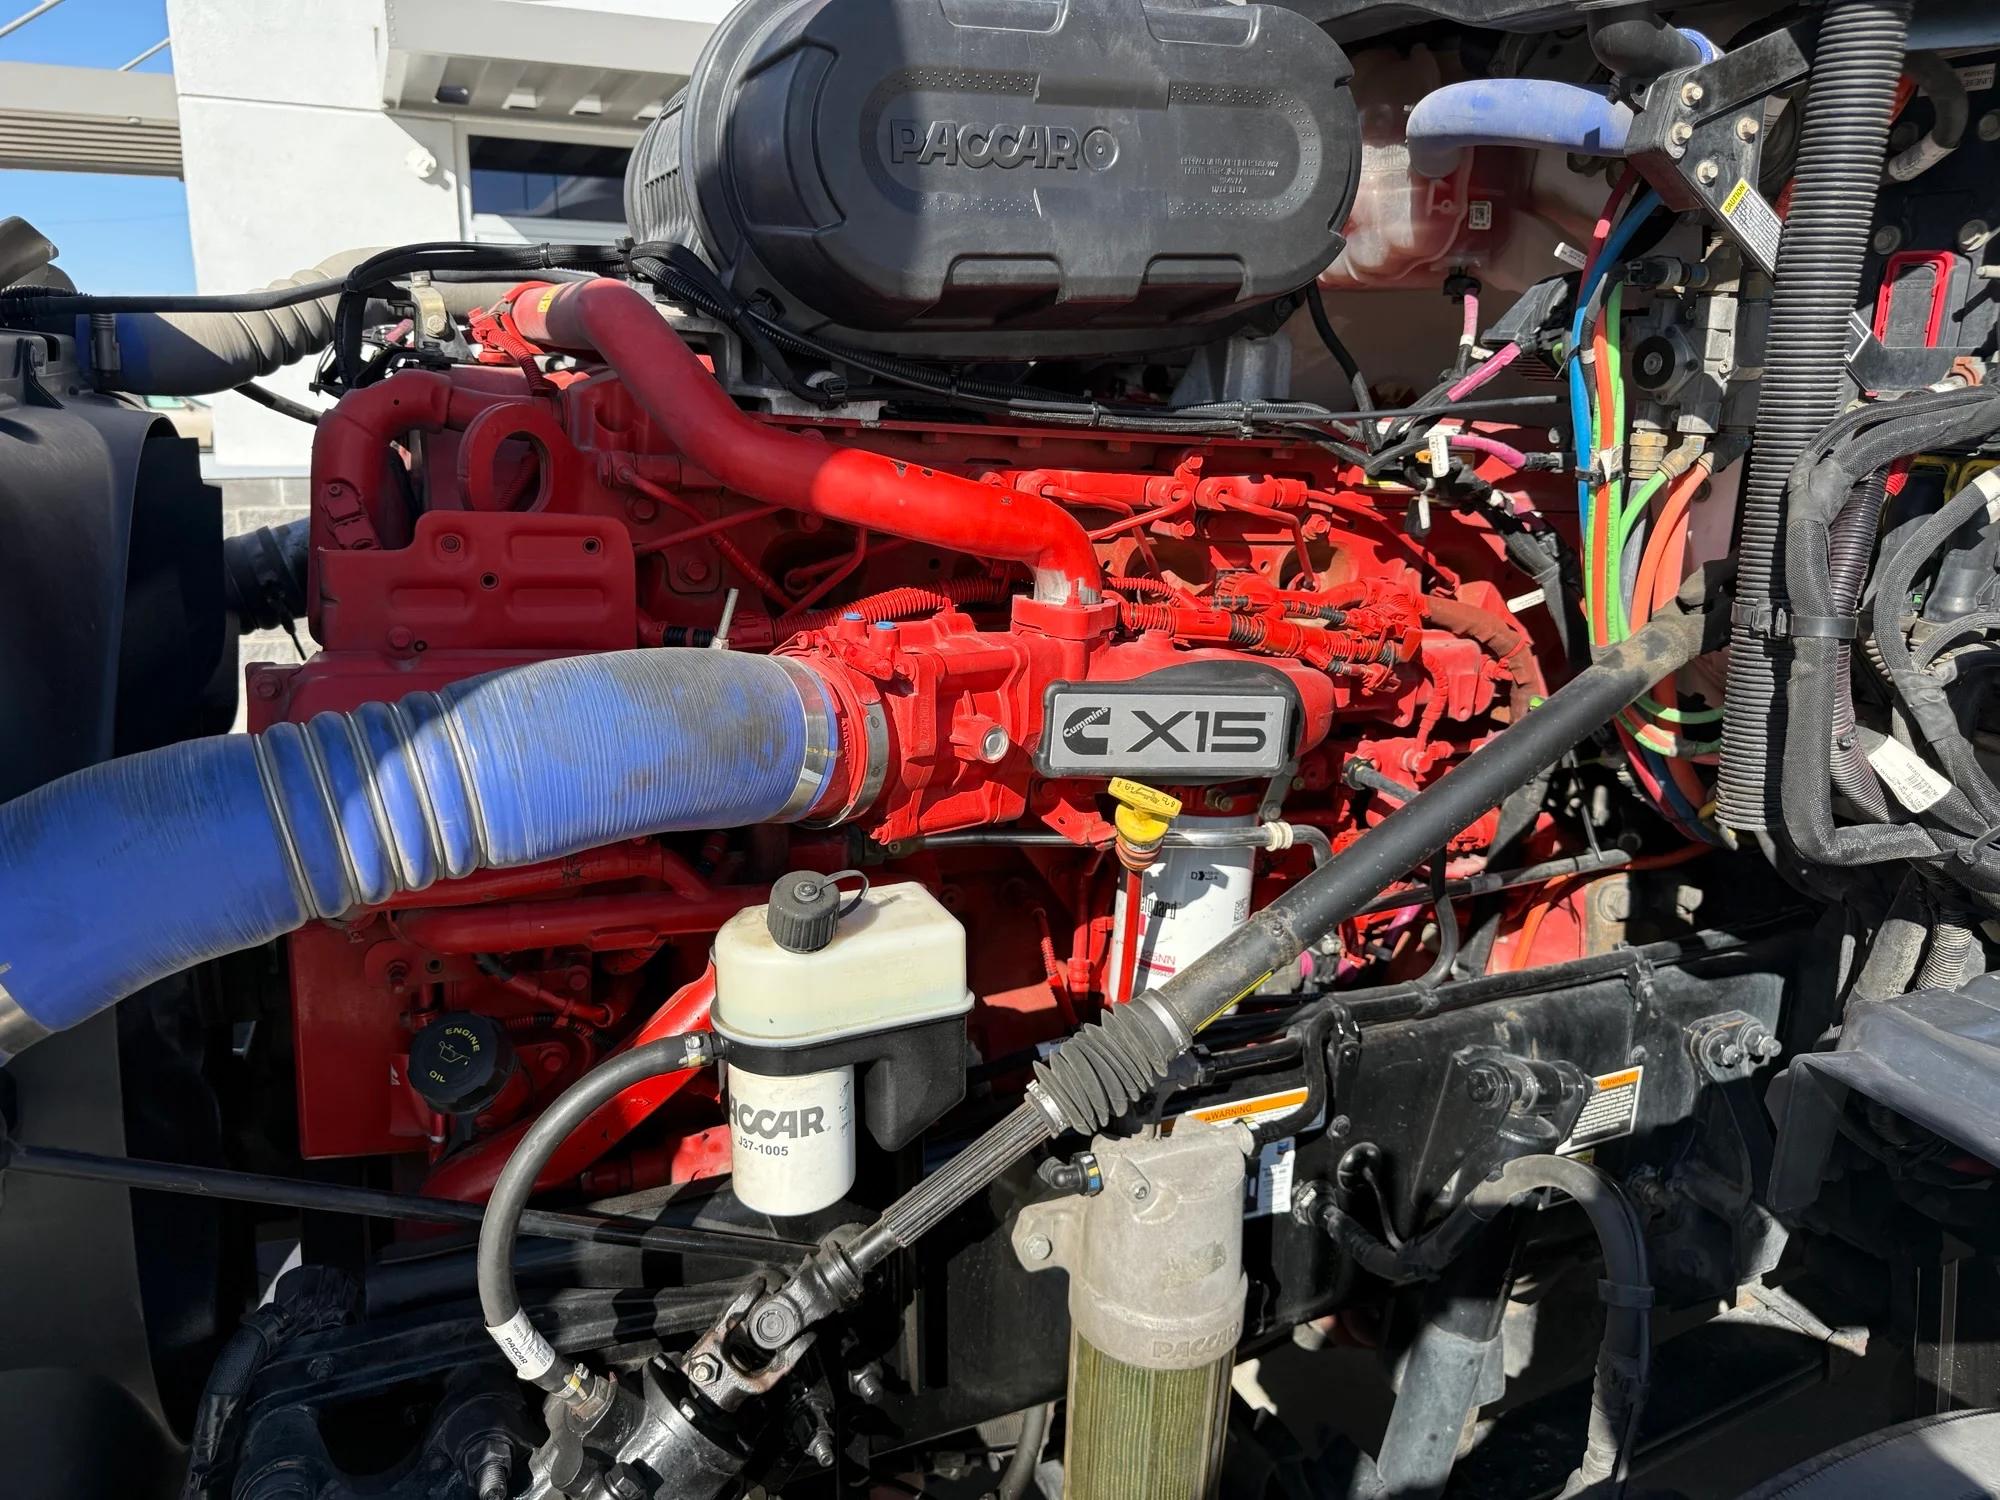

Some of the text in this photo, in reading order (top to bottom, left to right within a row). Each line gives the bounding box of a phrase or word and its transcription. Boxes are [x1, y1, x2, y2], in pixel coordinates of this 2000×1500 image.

[890, 118, 1079, 170] PACCAR
[1724, 183, 1746, 213] CAUTION
[1062, 705, 1109, 739] Cummins
[1124, 709, 1268, 753] X15
[444, 1027, 481, 1052] ENGINE
[429, 1070, 447, 1083] OIL
[729, 1092, 825, 1140] ACCAR
[1210, 1104, 1252, 1120] WARNING
[738, 1136, 789, 1157] J37-1005
[505, 1336, 529, 1365] PACCAR
